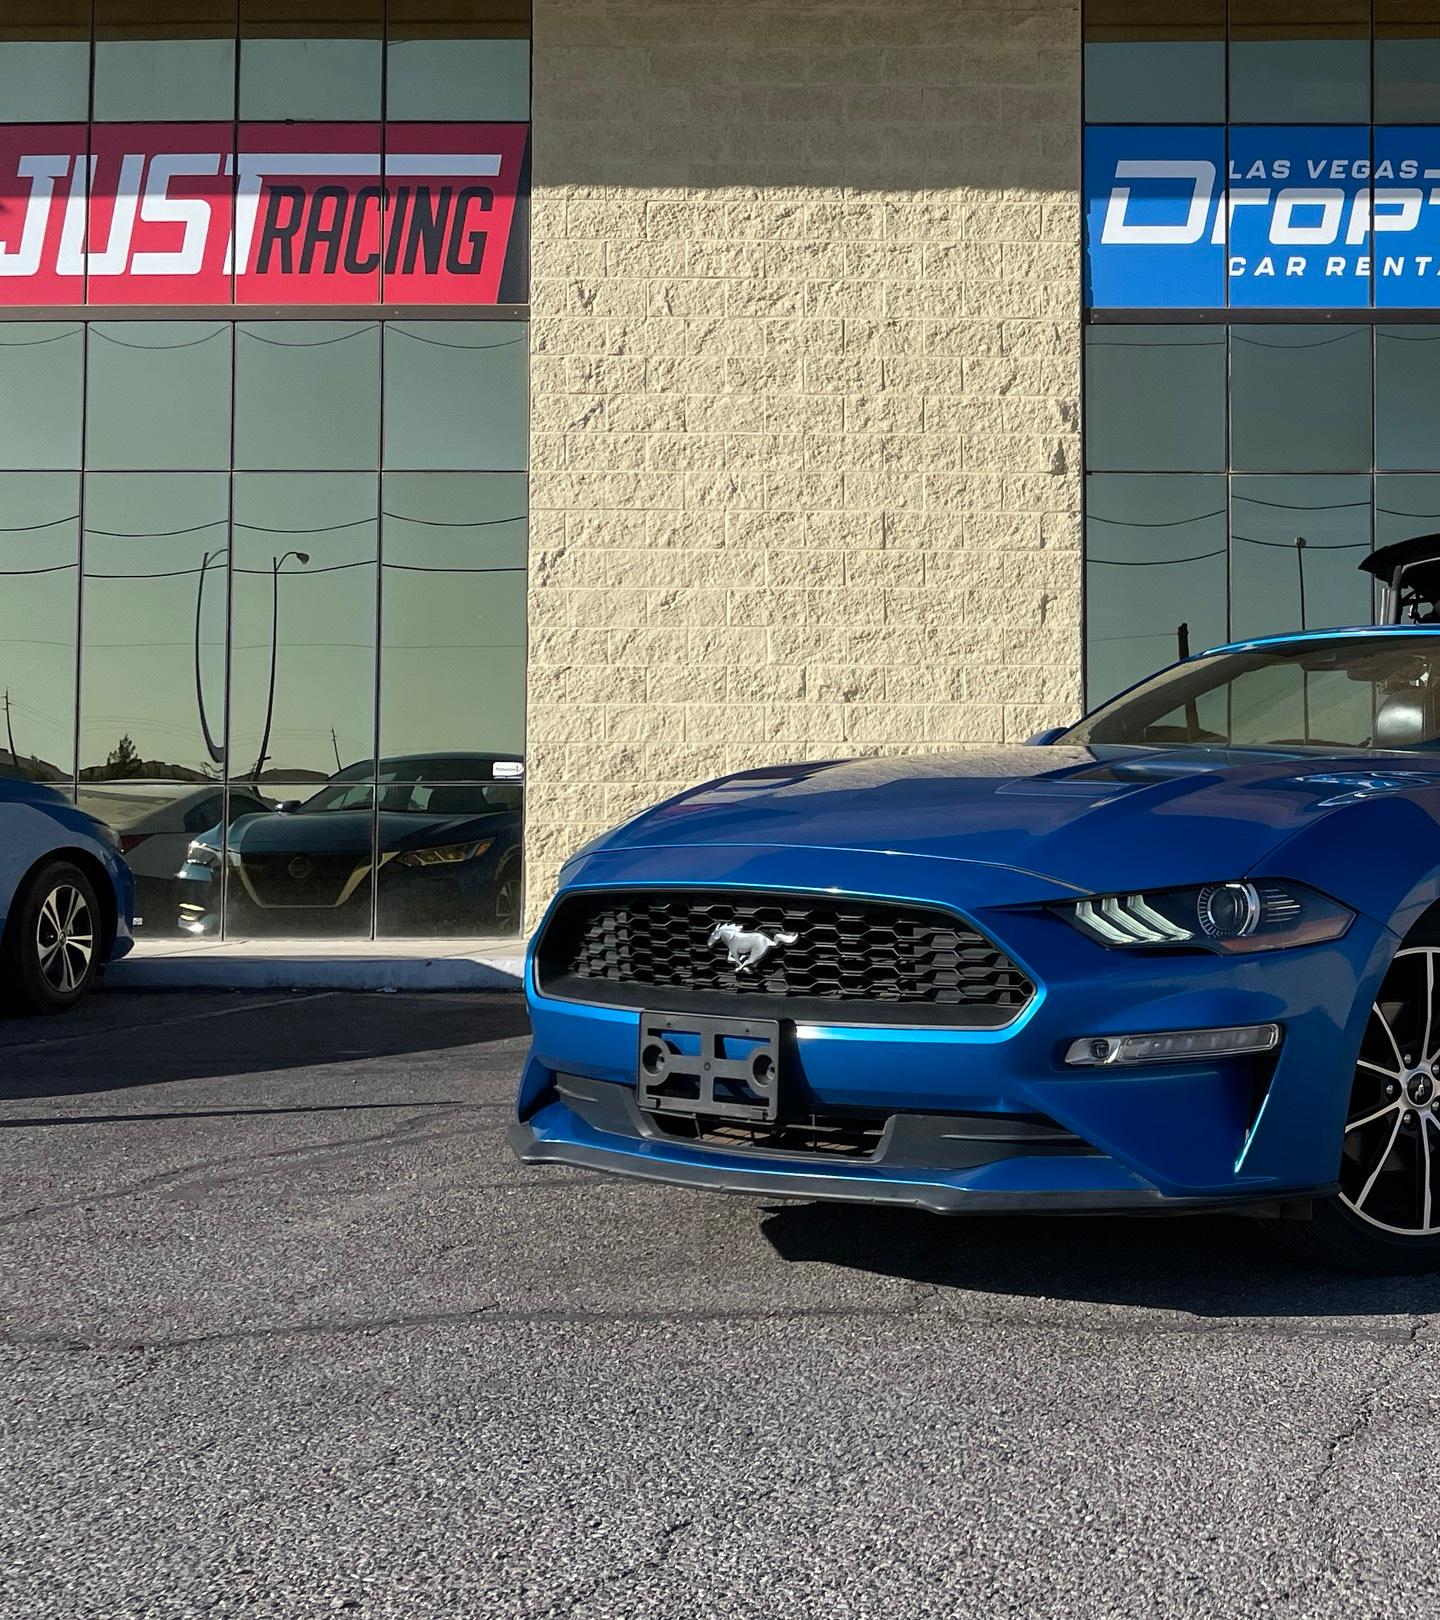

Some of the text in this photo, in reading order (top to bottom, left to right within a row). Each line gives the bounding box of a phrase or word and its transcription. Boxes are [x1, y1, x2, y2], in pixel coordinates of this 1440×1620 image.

[1228, 160, 1419, 179] LAS VEGAS
[0, 153, 502, 276] JUST RACING
[1228, 256, 1307, 277] CAR
